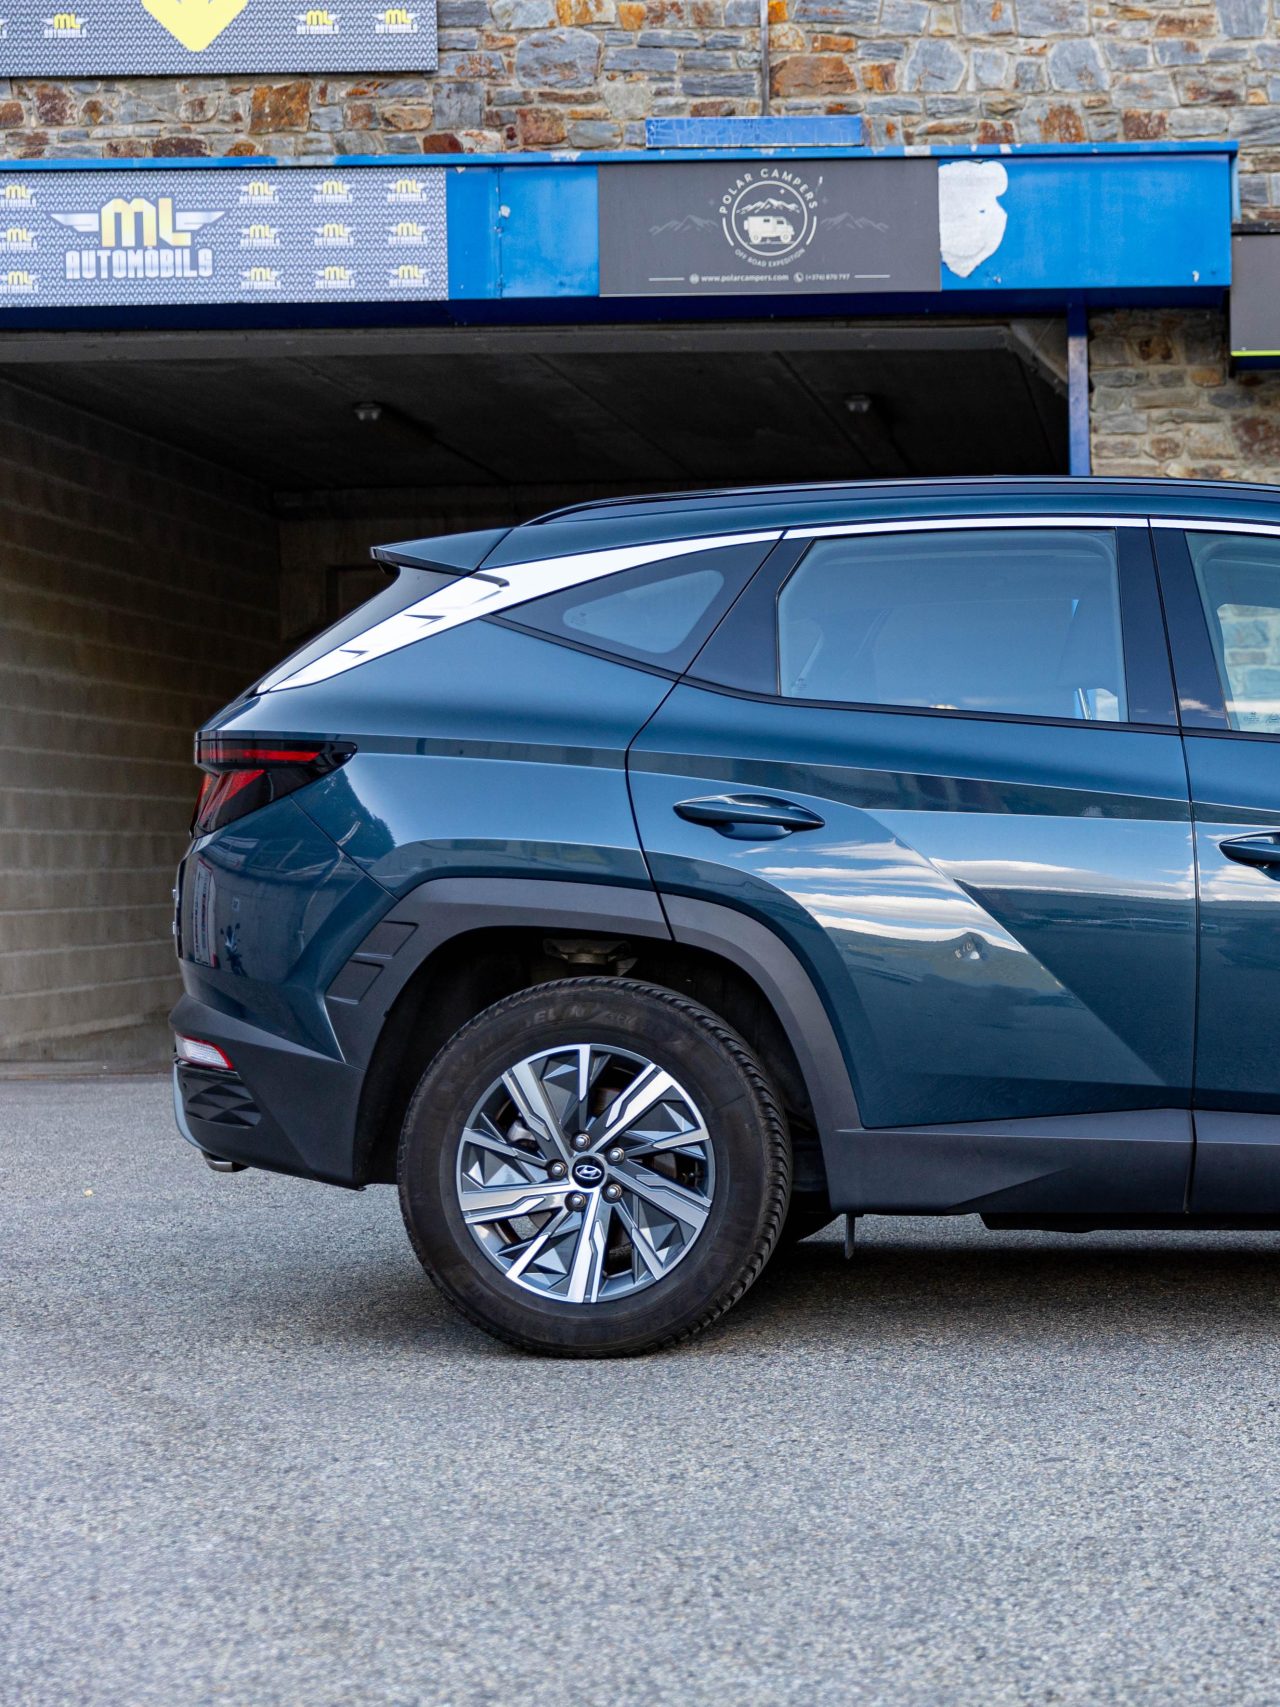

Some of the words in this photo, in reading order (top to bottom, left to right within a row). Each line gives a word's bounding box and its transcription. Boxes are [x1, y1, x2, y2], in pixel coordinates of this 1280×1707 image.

[53, 14, 80, 29] ML
[306, 10, 333, 26] ML
[385, 9, 412, 25] ML
[719, 173, 753, 214] POLAR
[760, 168, 818, 209] CAMPERS
[101, 198, 191, 247] ML
